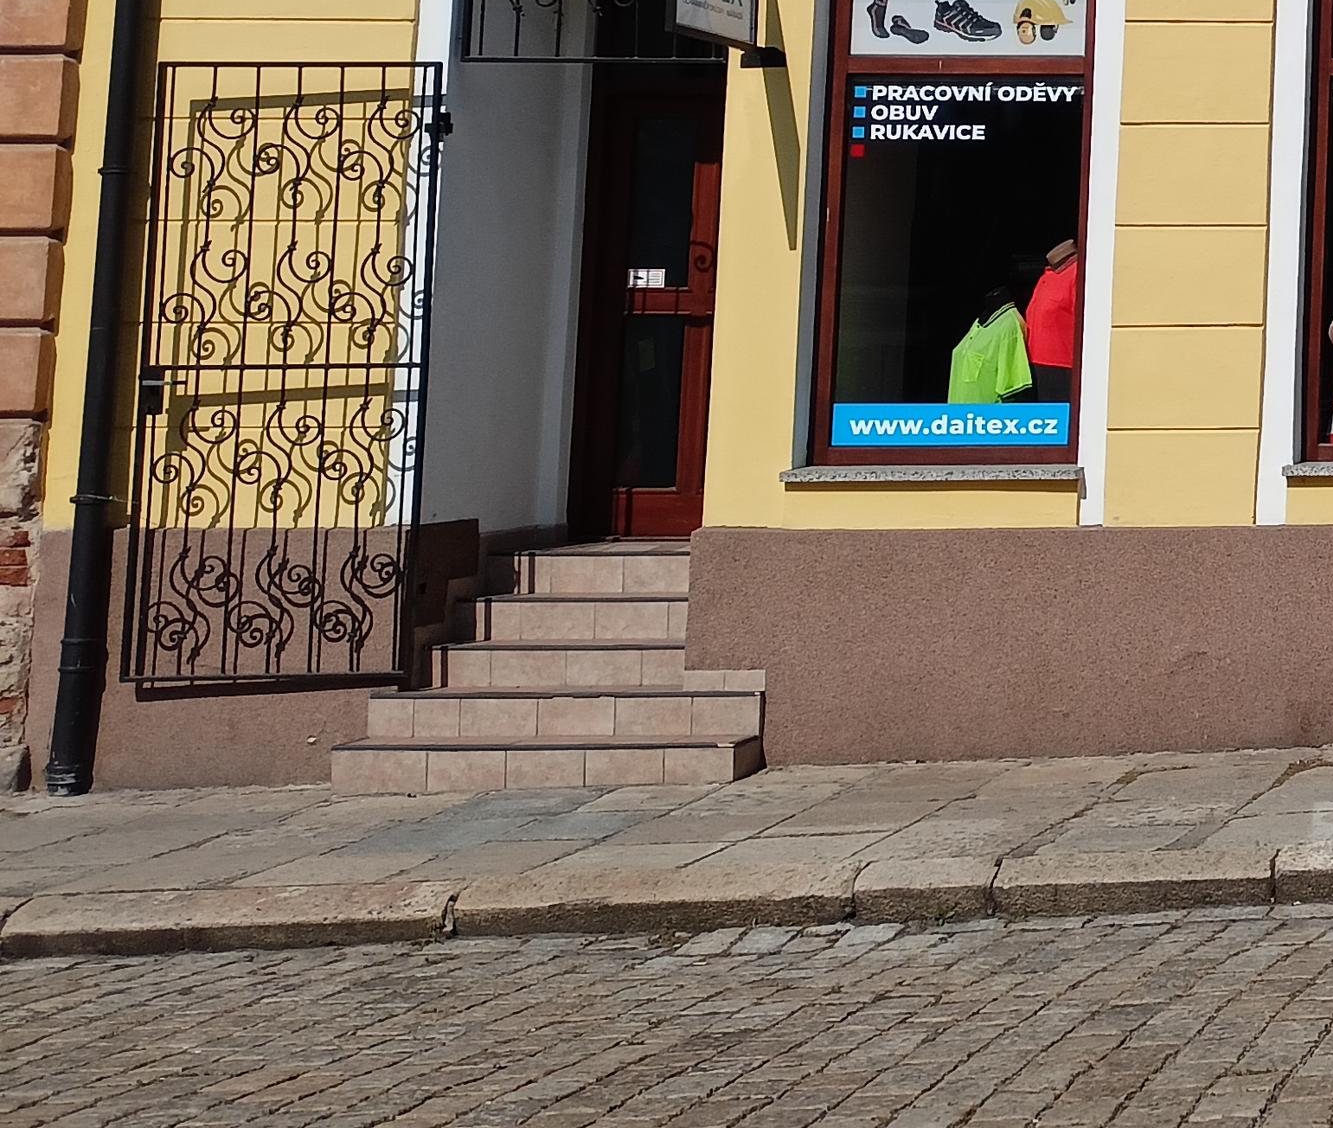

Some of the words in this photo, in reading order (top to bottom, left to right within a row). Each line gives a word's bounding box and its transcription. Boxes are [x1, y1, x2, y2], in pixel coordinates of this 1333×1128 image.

[872, 82, 993, 102] PRACOVNÍ
[997, 82, 1077, 102] ODĚVY
[870, 104, 939, 121] OBUV
[869, 124, 986, 141] RUKAVICE
[849, 413, 1059, 436] www.daitex.cz
